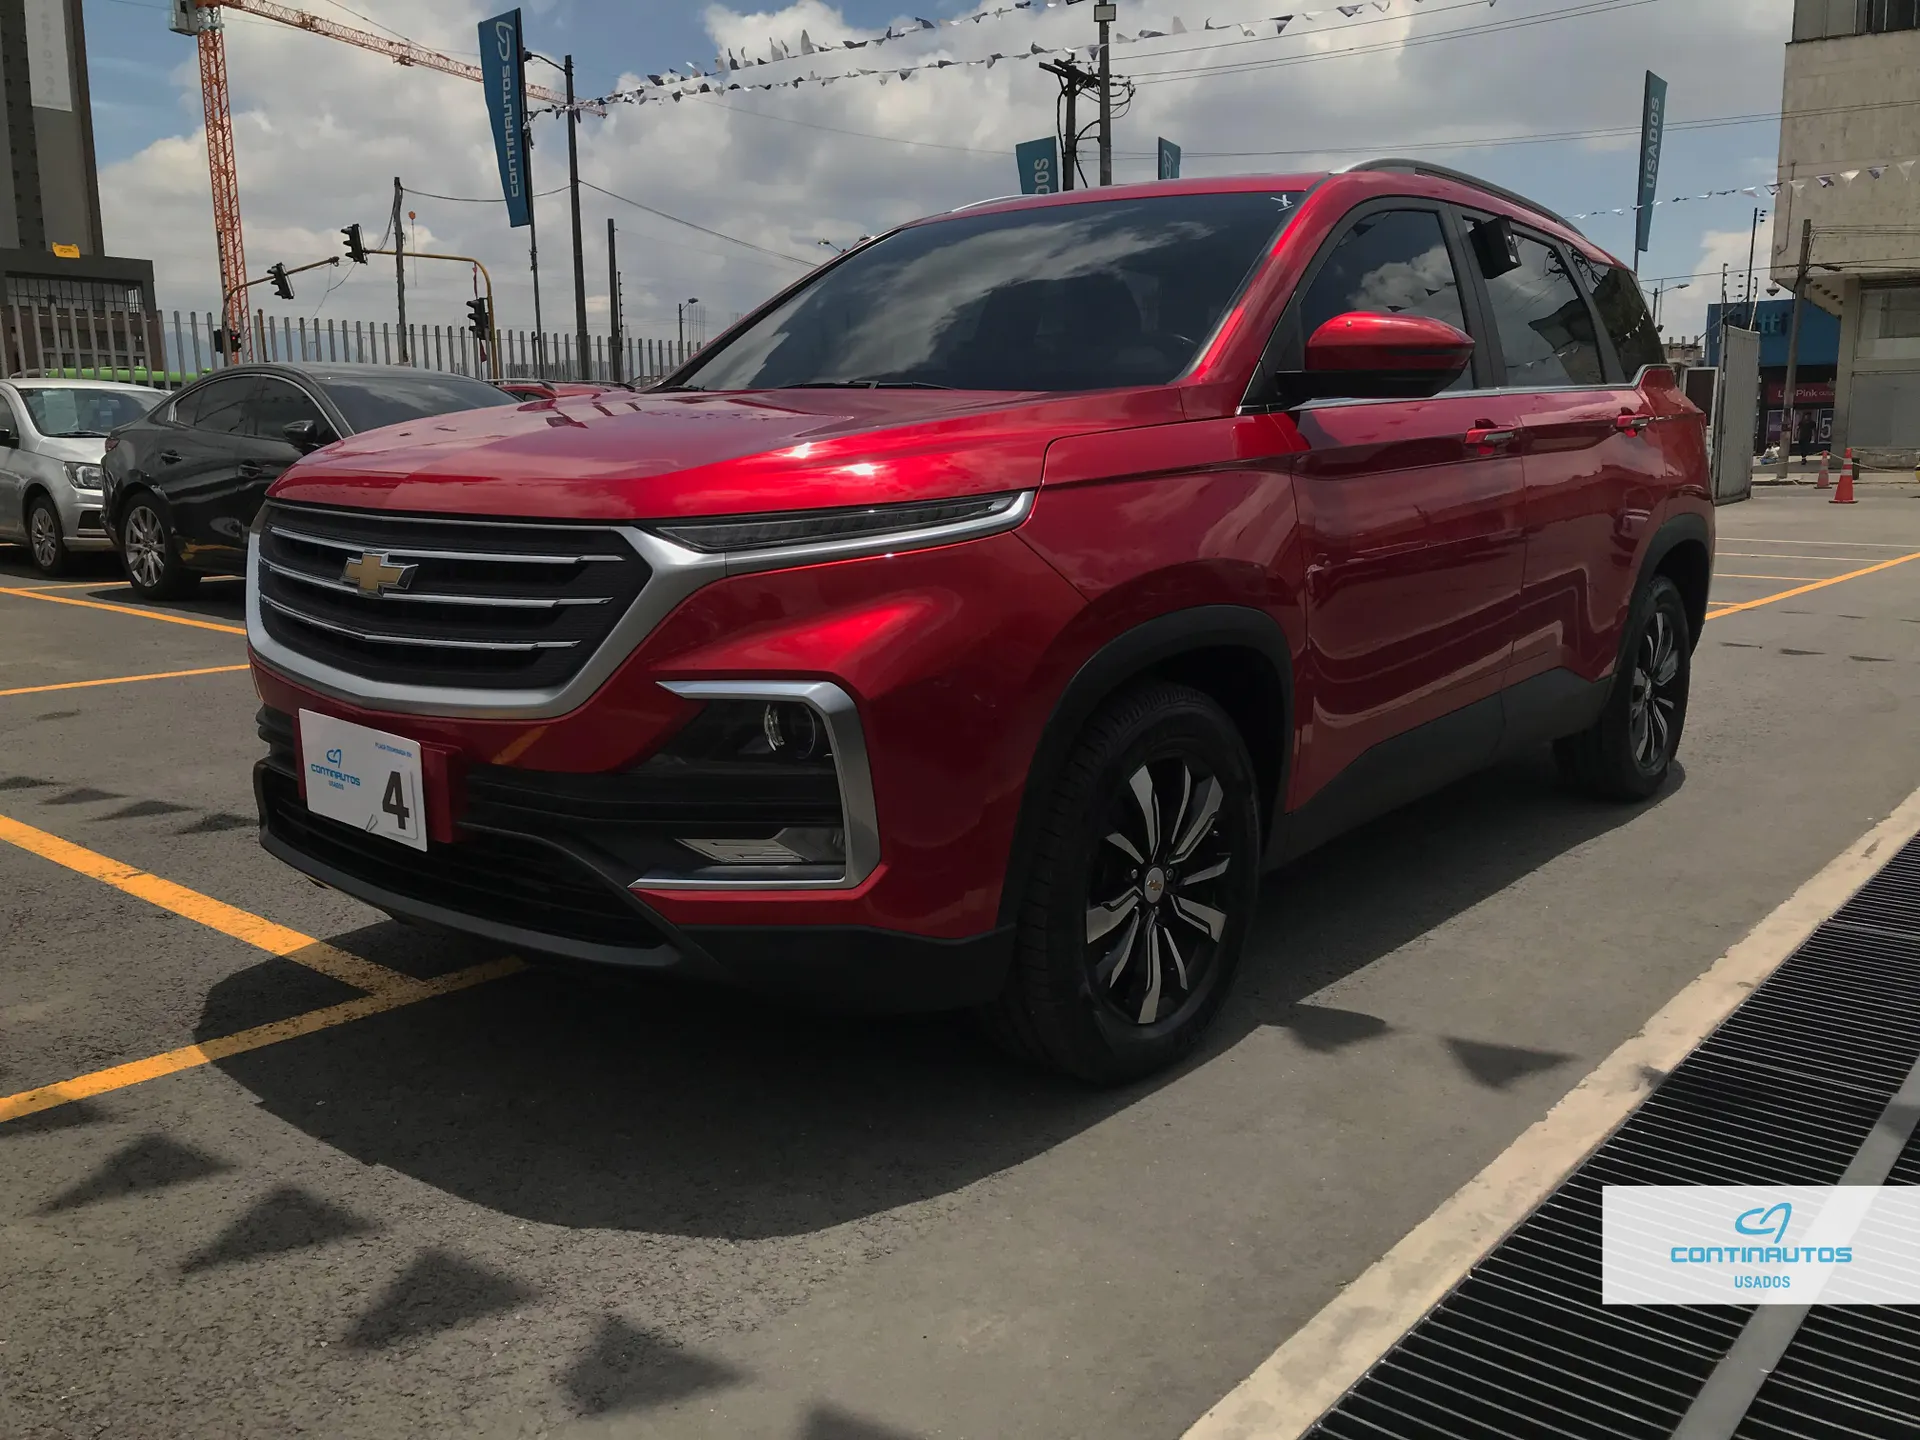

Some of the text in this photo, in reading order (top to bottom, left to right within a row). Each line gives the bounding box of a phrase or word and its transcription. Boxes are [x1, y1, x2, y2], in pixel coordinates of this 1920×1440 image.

[502, 64, 519, 198] CONTINAUTOS
[1646, 97, 1660, 188] USADOS
[310, 763, 361, 787] CONTINAUTOS
[382, 770, 410, 831] 4
